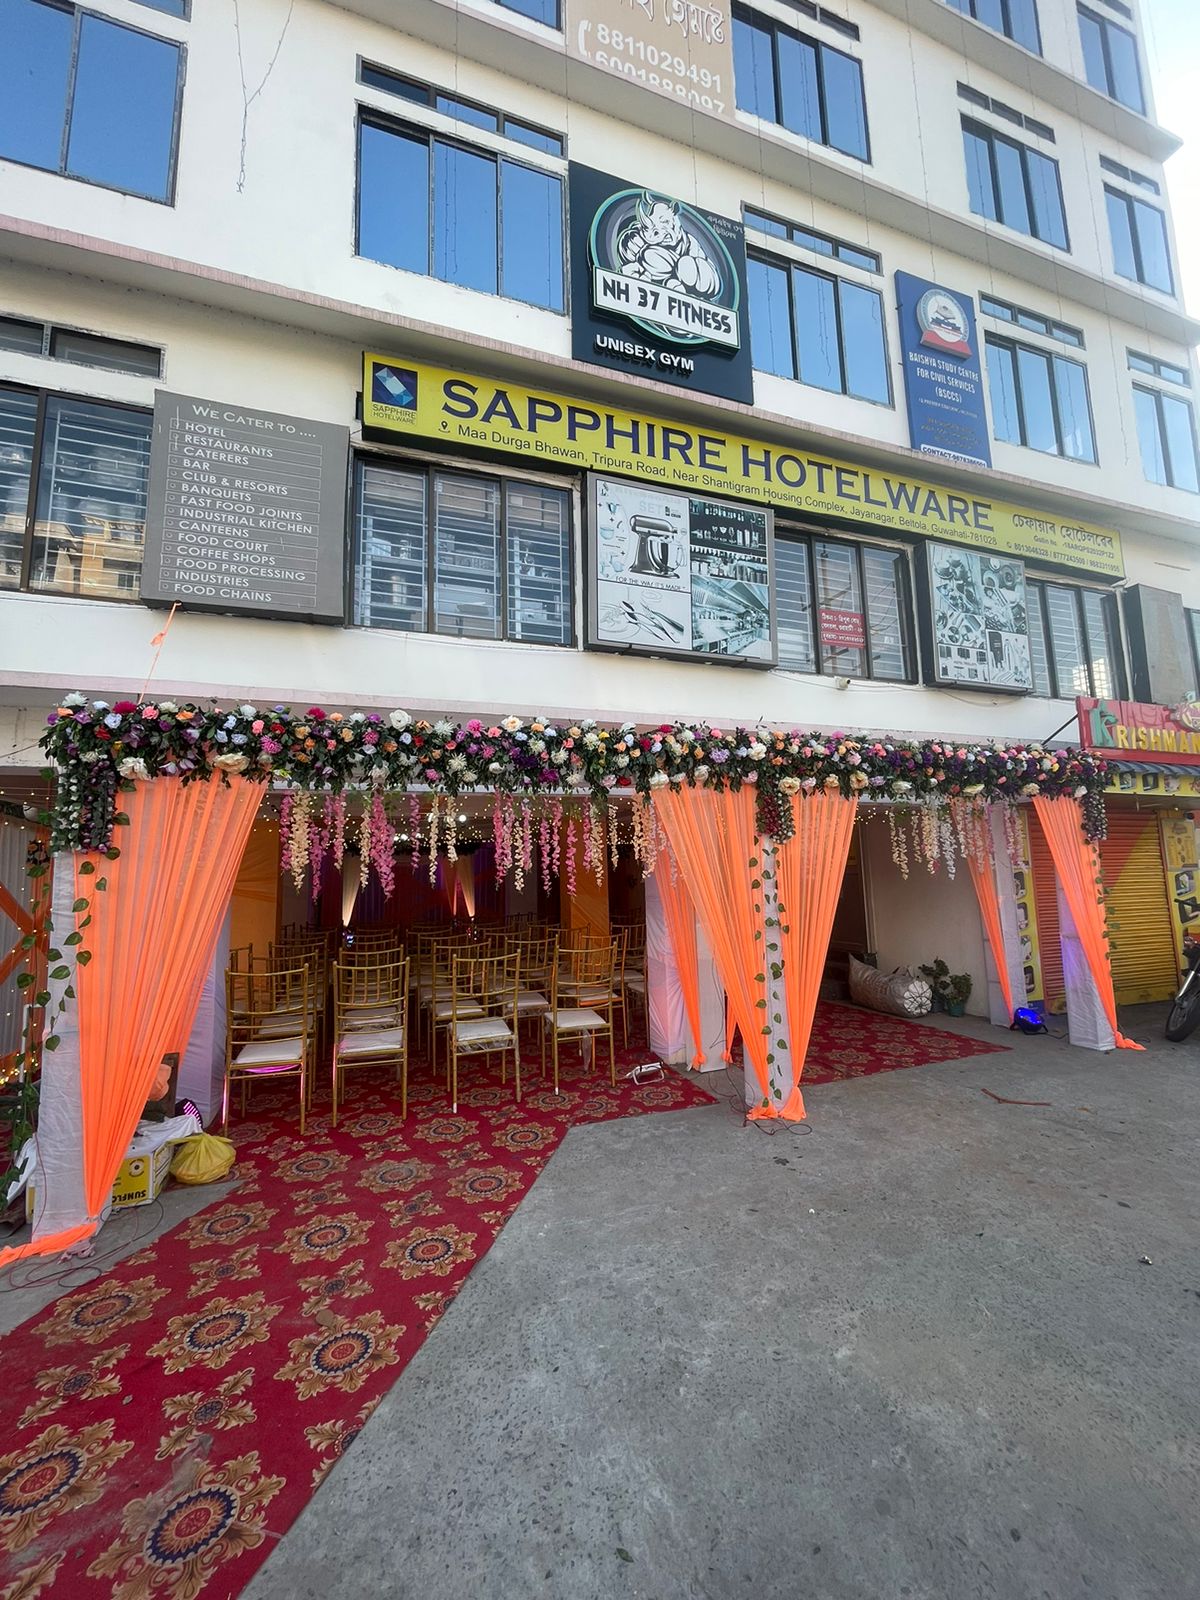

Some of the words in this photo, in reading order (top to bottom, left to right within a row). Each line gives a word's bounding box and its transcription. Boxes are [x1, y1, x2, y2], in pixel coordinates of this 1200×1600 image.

[596, 23, 721, 93] 8811029491
[603, 276, 630, 303] NH
[637, 286, 660, 310] 37
[668, 296, 732, 335] FITNESS
[596, 334, 656, 361] UNISEX
[660, 352, 694, 371] GYM
[909, 351, 936, 367] BAISHYA
[937, 359, 957, 374] STUDY
[958, 367, 979, 382] CENTRE
[917, 367, 930, 379] FOR
[930, 371, 946, 384] CIVIL
[947, 376, 975, 394] SERVICES
[935, 386, 962, 403] (BSCCS)
[223, 411, 274, 430] CATER
[277, 423, 296, 433] TO
[372, 403, 416, 419] SAPPHIRE
[373, 411, 415, 425] HOTELWARE
[185, 422, 226, 437] HOTEL
[183, 447, 249, 465] CATERERS
[185, 434, 273, 457] RESTAURANTS
[442, 379, 727, 473] SAPPHIRE
[741, 444, 994, 532] HOTELWARE
[183, 458, 210, 471] BAR
[181, 484, 251, 501] BANQUETS
[182, 471, 216, 484] CLUB
[221, 478, 229, 486] &
[235, 480, 288, 495] RESORTS
[458, 424, 487, 440] Maa
[491, 431, 530, 450] Durga
[535, 441, 588, 462] Bhawan,
[592, 451, 632, 470] Tripura
[636, 462, 669, 479] Road,
[673, 469, 698, 483] Near
[702, 475, 760, 495] Shantigram
[763, 487, 802, 506] Housing
[804, 496, 848, 515] Complex,
[850, 506, 897, 525] Jayanagar,
[931, 523, 997, 546] Guwahati-781028
[181, 495, 211, 508] FAST
[216, 501, 255, 514] FOOD
[259, 507, 302, 521] JOINTS
[179, 521, 249, 538] CANTEENS
[180, 508, 255, 527] INDUSTRIAL
[259, 520, 312, 534] KITCHEN
[178, 533, 218, 546] FOOD
[223, 539, 269, 552] COURT
[177, 546, 229, 560] COFFEE
[233, 552, 275, 566] SHOPS
[175, 571, 249, 587] INDUSTRIES
[176, 558, 217, 571] FOOD
[222, 563, 306, 581] PROCESSING
[174, 584, 216, 596] FOOD
[220, 588, 272, 602] CHAINS
